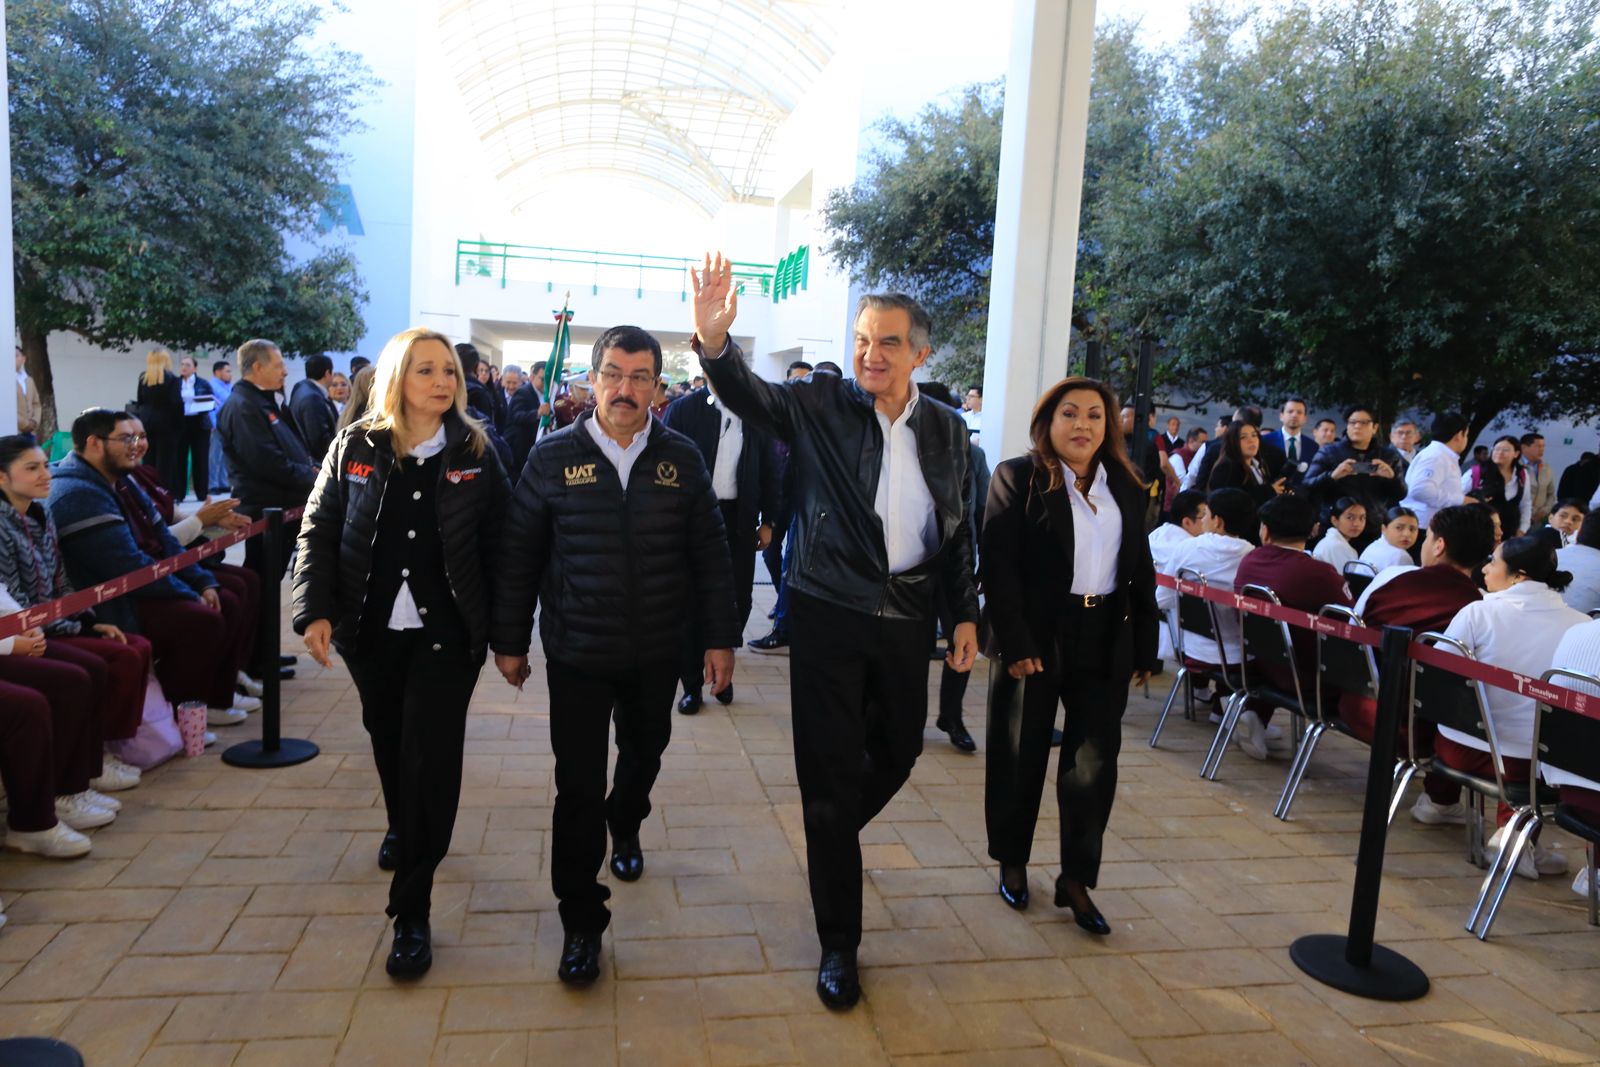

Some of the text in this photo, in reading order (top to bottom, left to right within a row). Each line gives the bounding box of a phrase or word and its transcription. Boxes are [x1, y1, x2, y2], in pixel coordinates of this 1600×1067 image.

[347, 461, 375, 478] UAT
[564, 464, 596, 480] UAT
[1528, 684, 1559, 701] Tamaulipas
